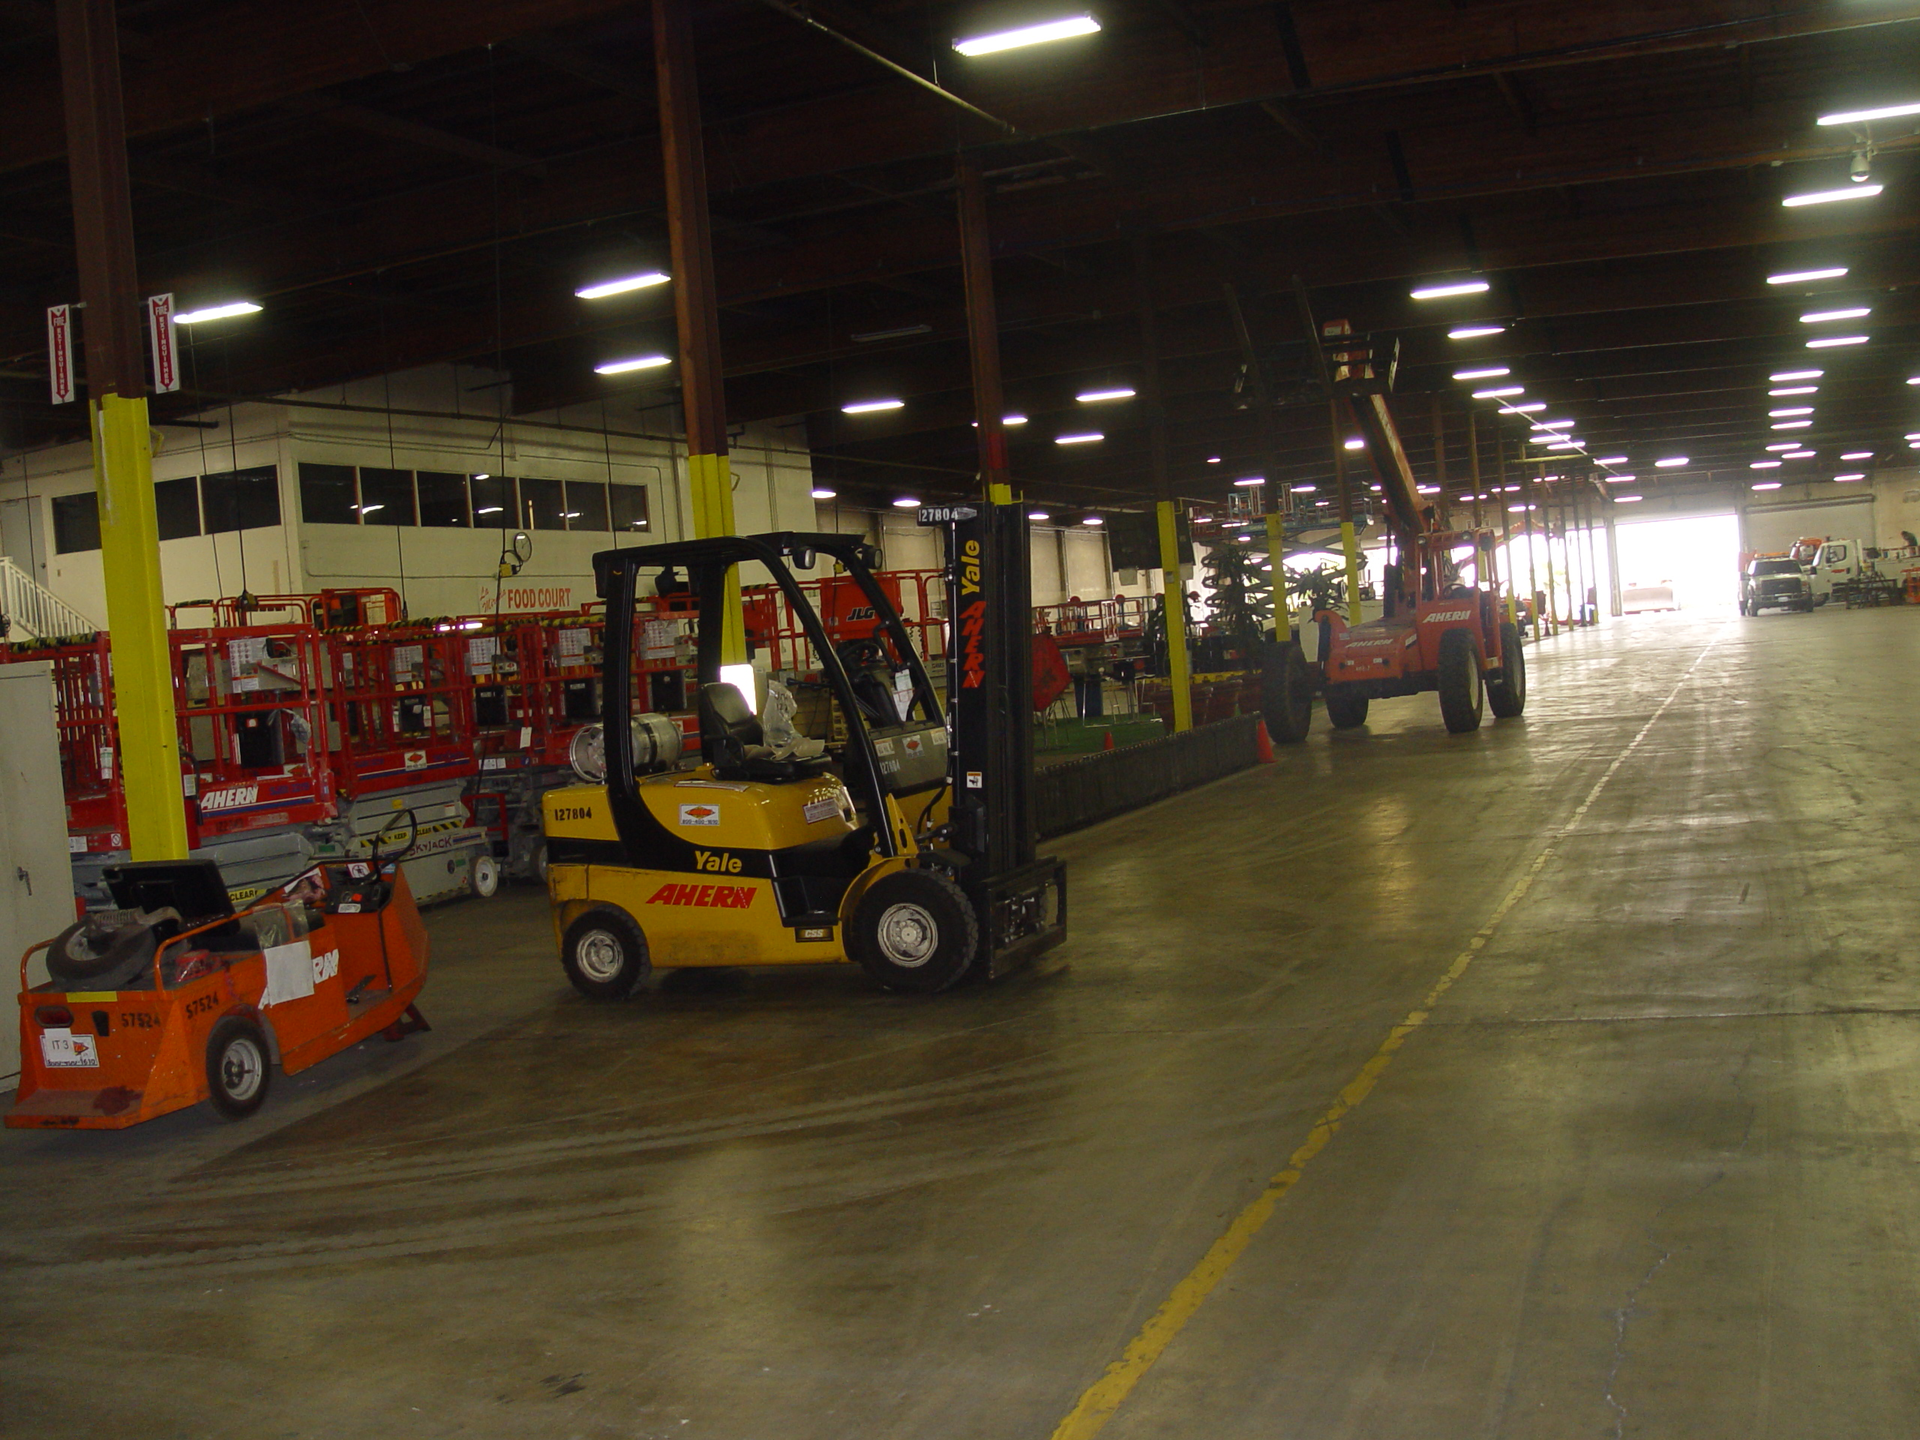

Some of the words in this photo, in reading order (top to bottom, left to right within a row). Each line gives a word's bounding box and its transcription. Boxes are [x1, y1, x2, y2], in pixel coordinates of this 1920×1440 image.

[155, 305, 168, 317] FIRE
[159, 316, 170, 385] EXTINGUISHER
[918, 507, 959, 523] 127804
[961, 539, 981, 596] Yale
[507, 588, 536, 609] FOOD
[538, 587, 571, 608] COURT
[846, 606, 875, 622] JLG
[1422, 610, 1472, 624] AHERN
[959, 600, 987, 689] AHERN
[1345, 638, 1394, 649] AHERN
[201, 785, 259, 810] AHERN
[553, 806, 592, 821] 127804
[694, 850, 743, 873] Yale
[229, 889, 254, 902] CLEAR
[645, 883, 757, 909] AHERN
[186, 991, 220, 1019] 57524
[121, 1013, 161, 1028] 57524
